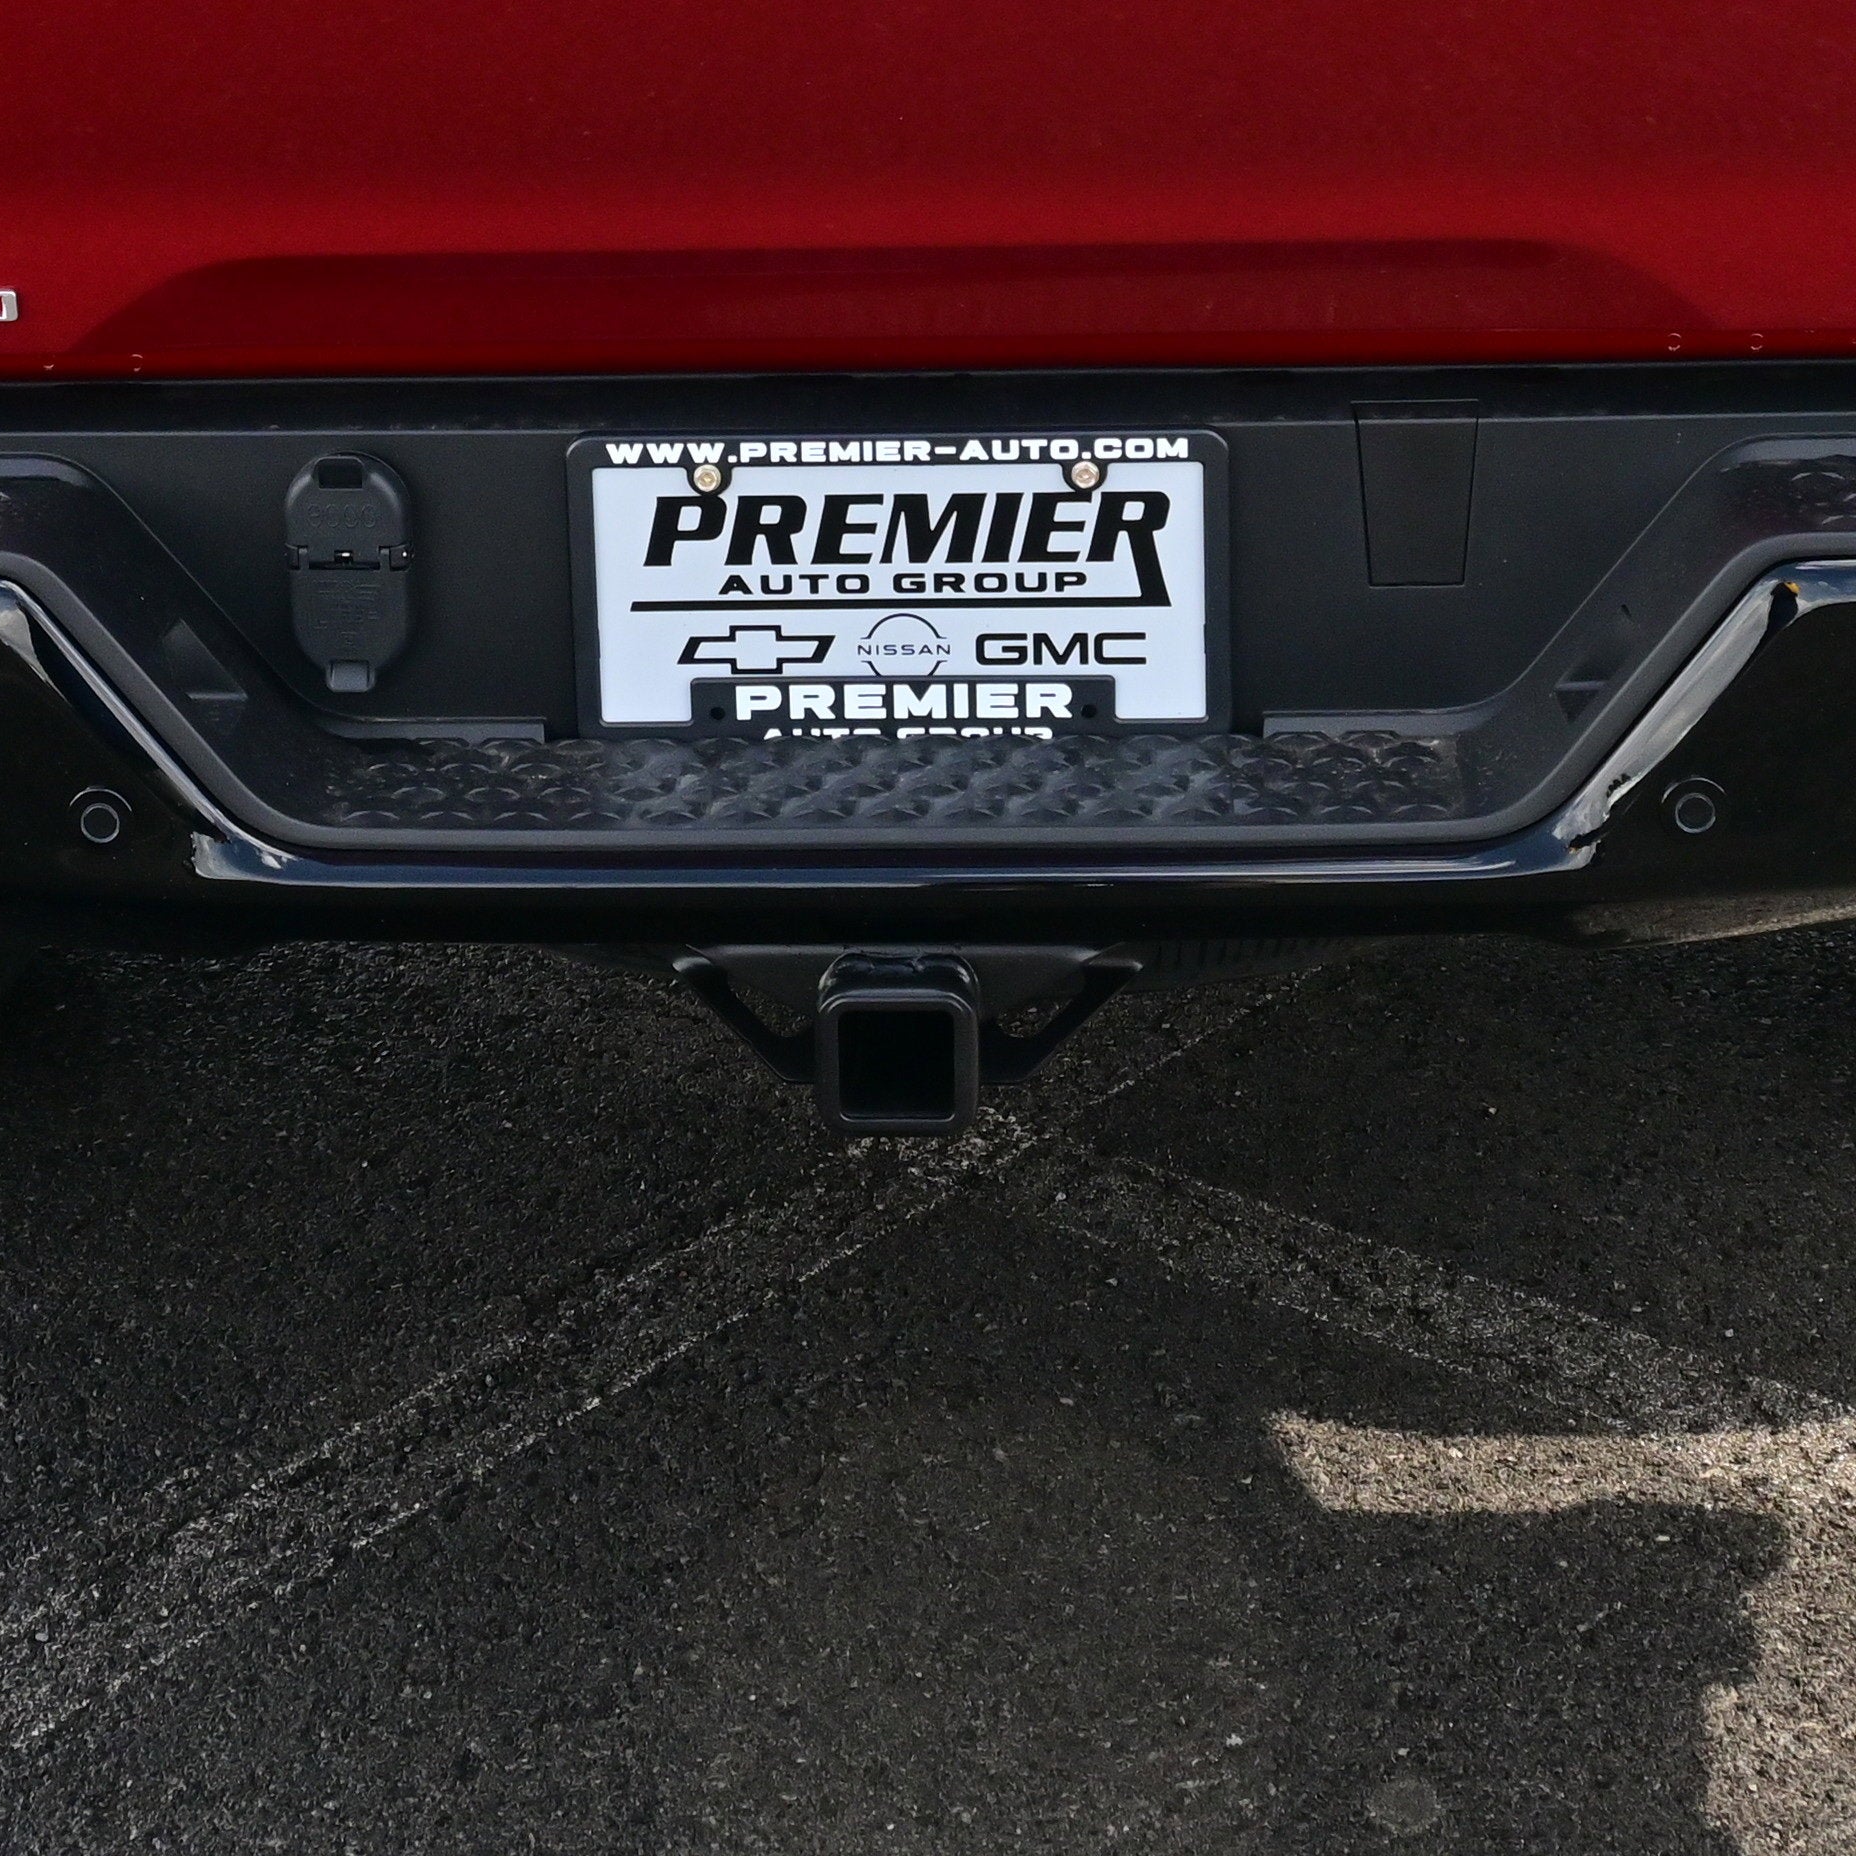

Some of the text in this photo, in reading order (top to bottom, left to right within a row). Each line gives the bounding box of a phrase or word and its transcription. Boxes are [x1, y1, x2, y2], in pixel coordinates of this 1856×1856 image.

[605, 437, 1190, 465] WWW.PREMIER-AUTO.COM
[642, 490, 1172, 568] PREMIER
[717, 571, 1088, 595] AUTO GROUP
[856, 643, 952, 657] NISSAN
[975, 631, 1147, 666] GMC
[734, 682, 1075, 721] PREMIER
